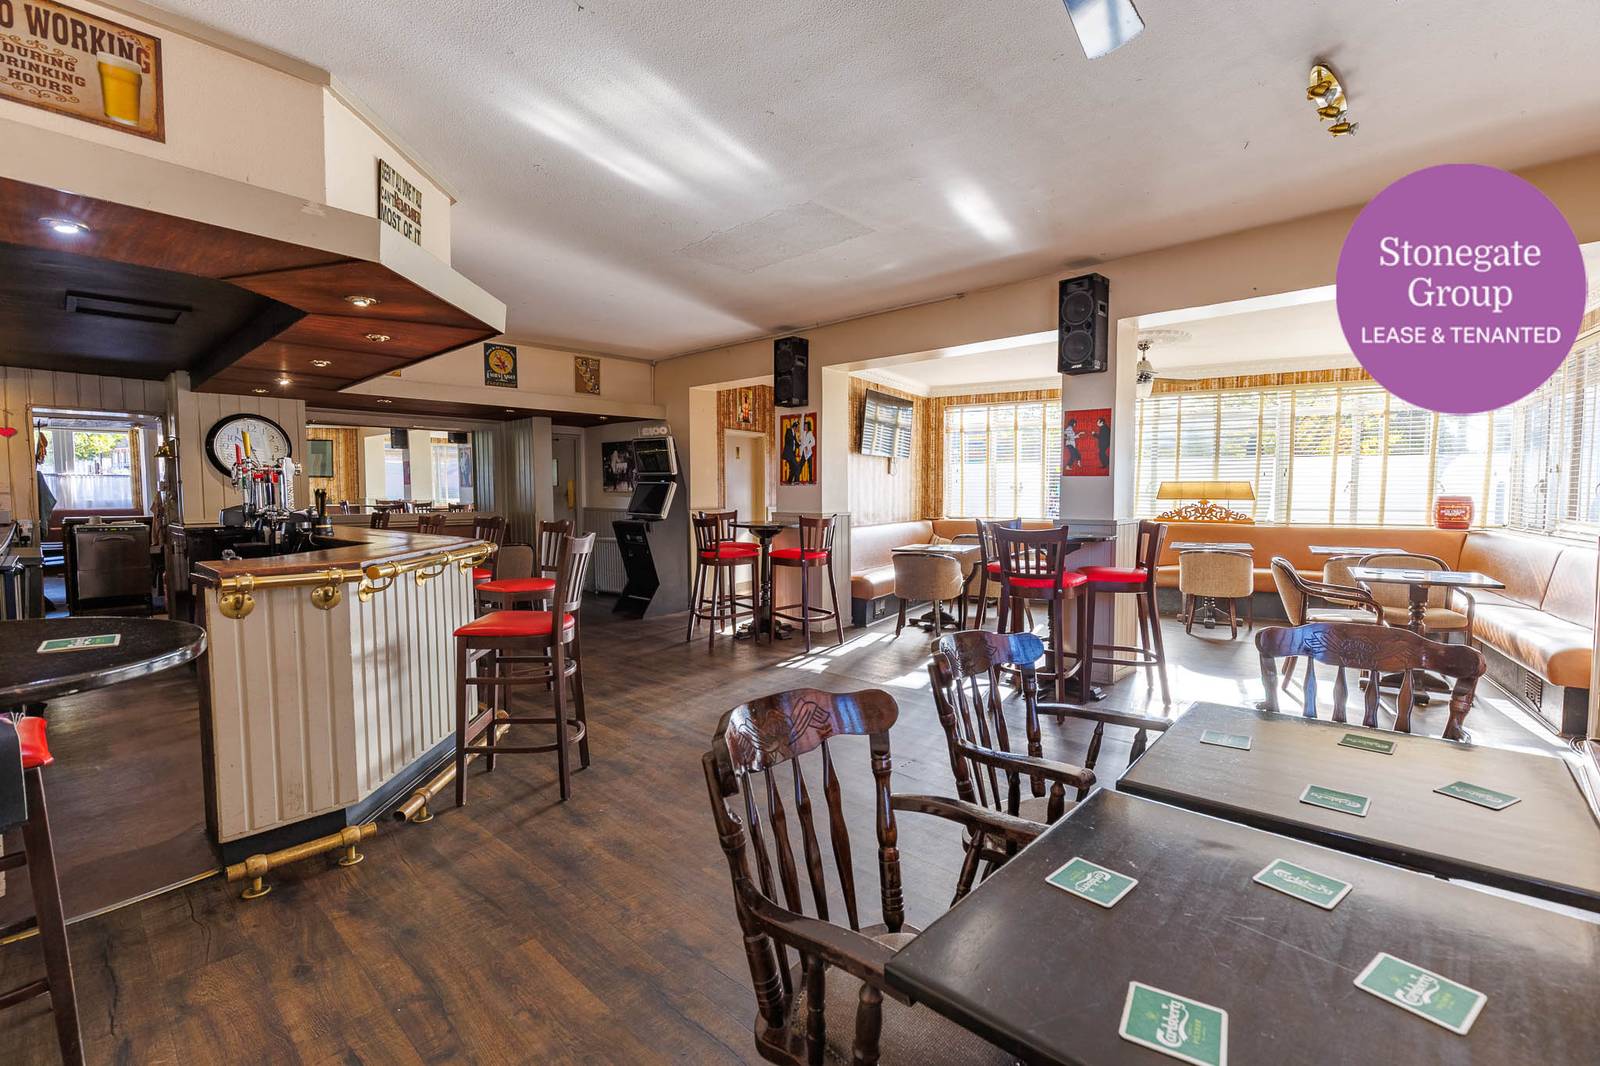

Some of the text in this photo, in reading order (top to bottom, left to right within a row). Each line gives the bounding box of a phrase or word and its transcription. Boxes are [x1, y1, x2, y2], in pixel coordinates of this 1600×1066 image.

[24, 4, 151, 74] WORKING
[3, 41, 76, 72] DURING
[8, 68, 73, 95] HOURS
[381, 203, 422, 247] MOST OF IT
[1075, 870, 1111, 893] Carlsberg
[1394, 973, 1440, 1006] Carlsberg
[1156, 1000, 1189, 1048] Carlsberg
